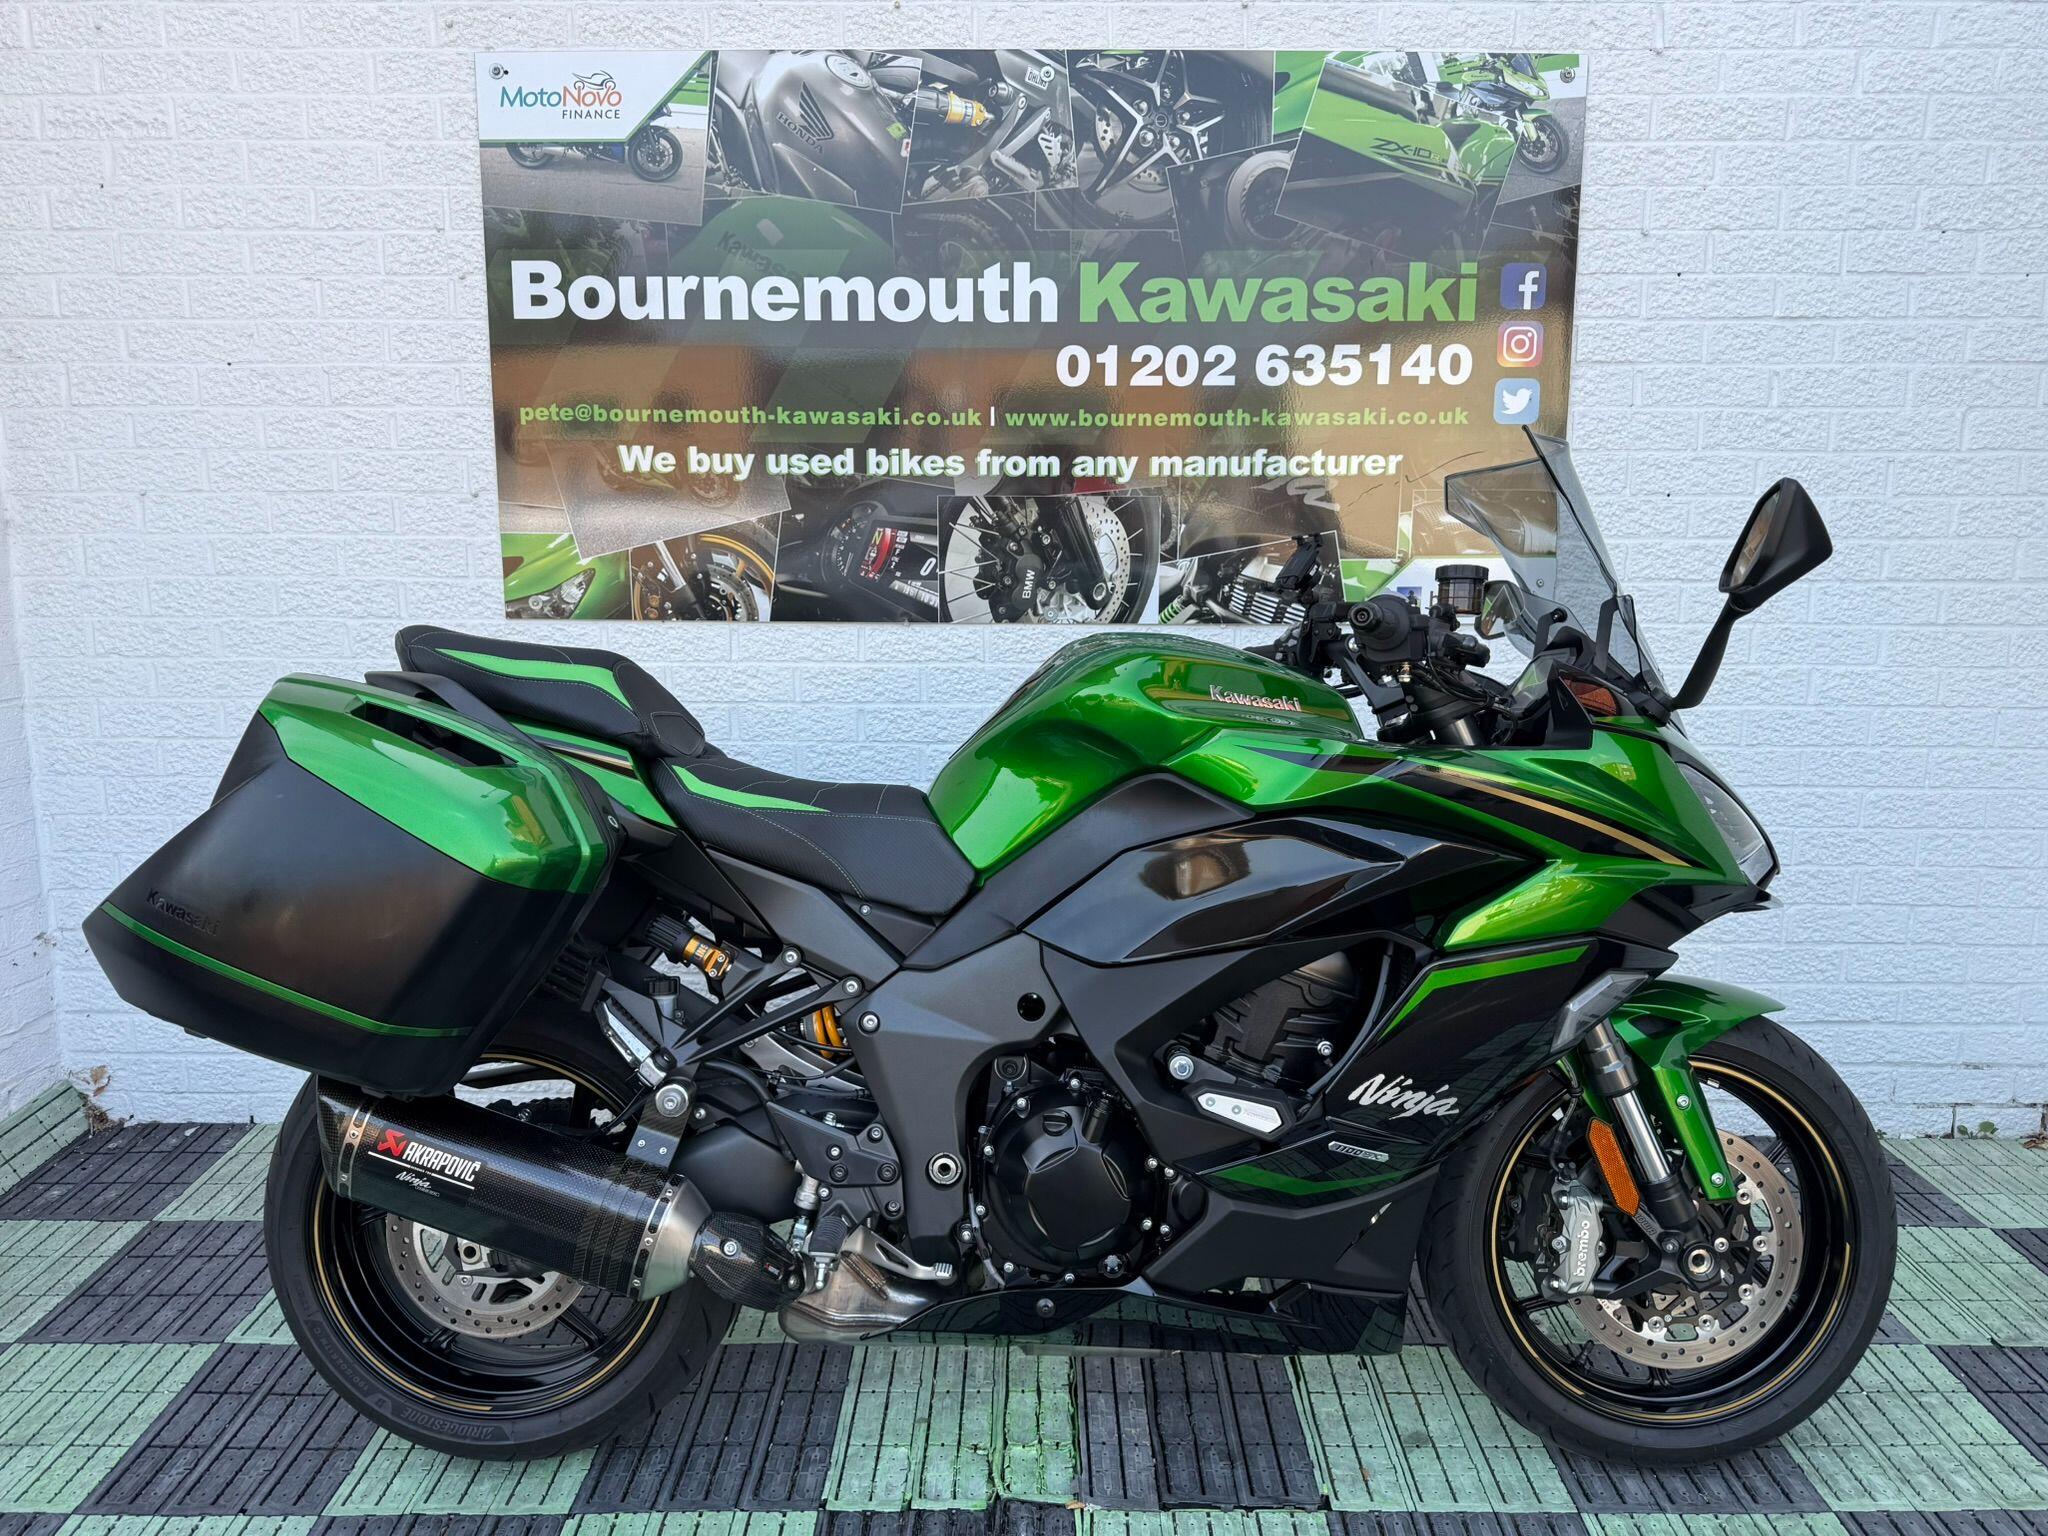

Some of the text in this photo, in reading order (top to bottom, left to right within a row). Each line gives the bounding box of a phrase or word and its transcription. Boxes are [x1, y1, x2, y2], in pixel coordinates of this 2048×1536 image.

[499, 86, 622, 107] MotoNovo
[561, 109, 621, 120] FINANCE
[776, 112, 823, 154] HONDA
[511, 260, 1478, 324] Bournemouth Kawasaki
[1056, 343, 1473, 387] 01202 635140
[519, 403, 983, 427] pete@bournemouth-kawasaki.co.uk
[1005, 407, 1470, 428] www.bournemouth-kawasaki.co.uk
[618, 444, 1404, 485] We buy used bikes from any manufacturer
[1022, 569, 1035, 599] BMW
[1209, 684, 1302, 712] Kawasaki
[1347, 1073, 1460, 1120] Ninja
[395, 1171, 431, 1189] Ninja
[1573, 1220, 1590, 1277] brembo
[401, 1407, 496, 1440] BRIDGESTONE
